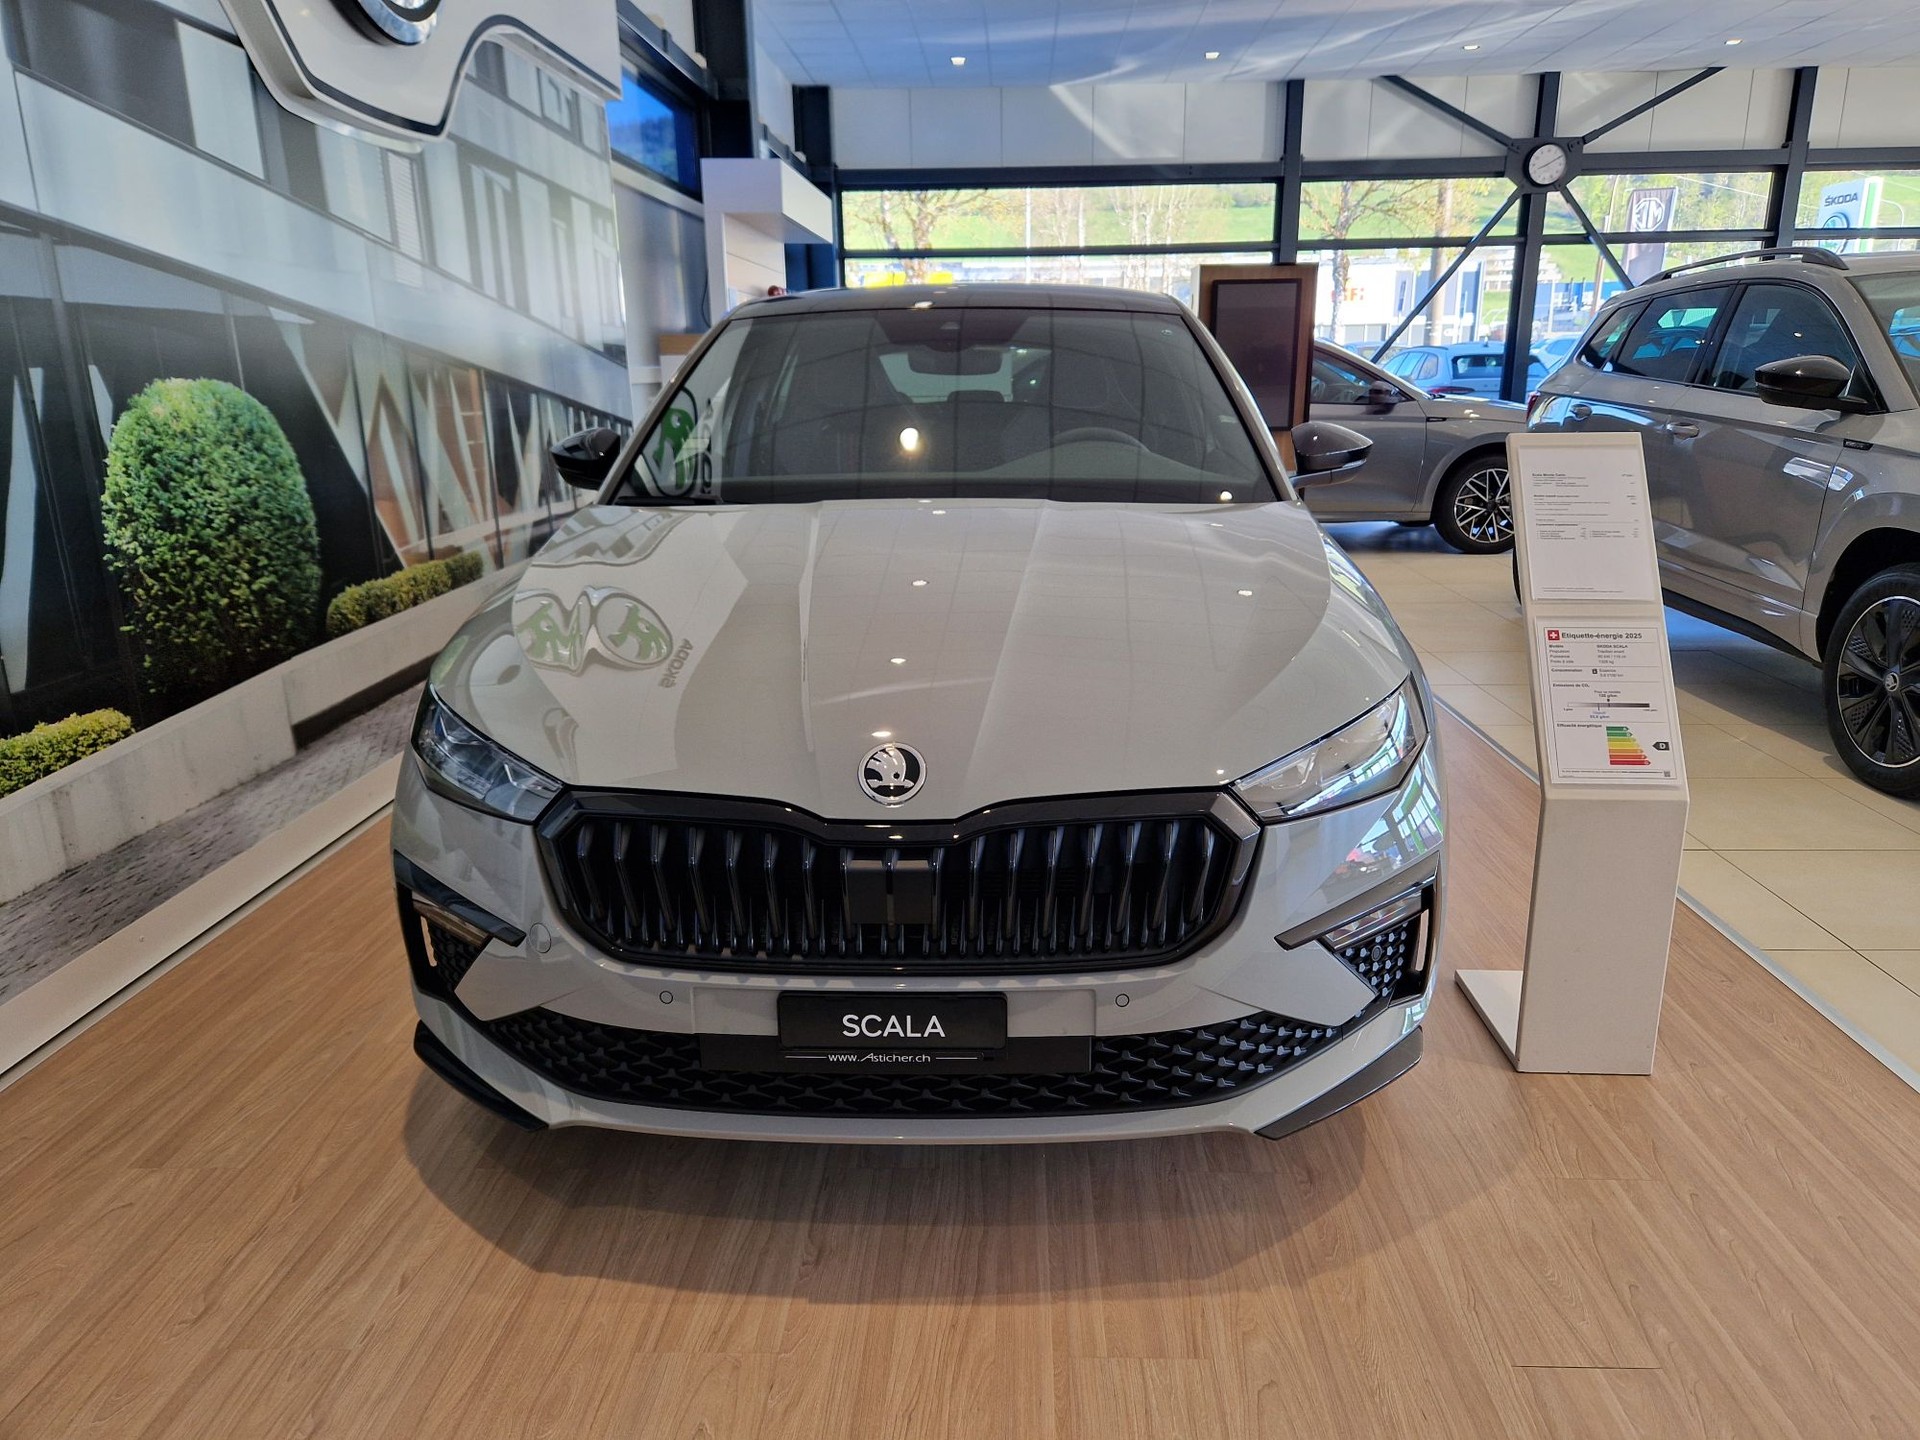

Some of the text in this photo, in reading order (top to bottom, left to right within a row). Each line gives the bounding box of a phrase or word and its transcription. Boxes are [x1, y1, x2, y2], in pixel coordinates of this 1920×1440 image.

[1824, 191, 1858, 207] ŠKODA
[1561, 632, 1624, 640] Etiquette-énergie
[842, 1014, 946, 1038] SCALA
[828, 1052, 931, 1063] www.Asticher.ch
